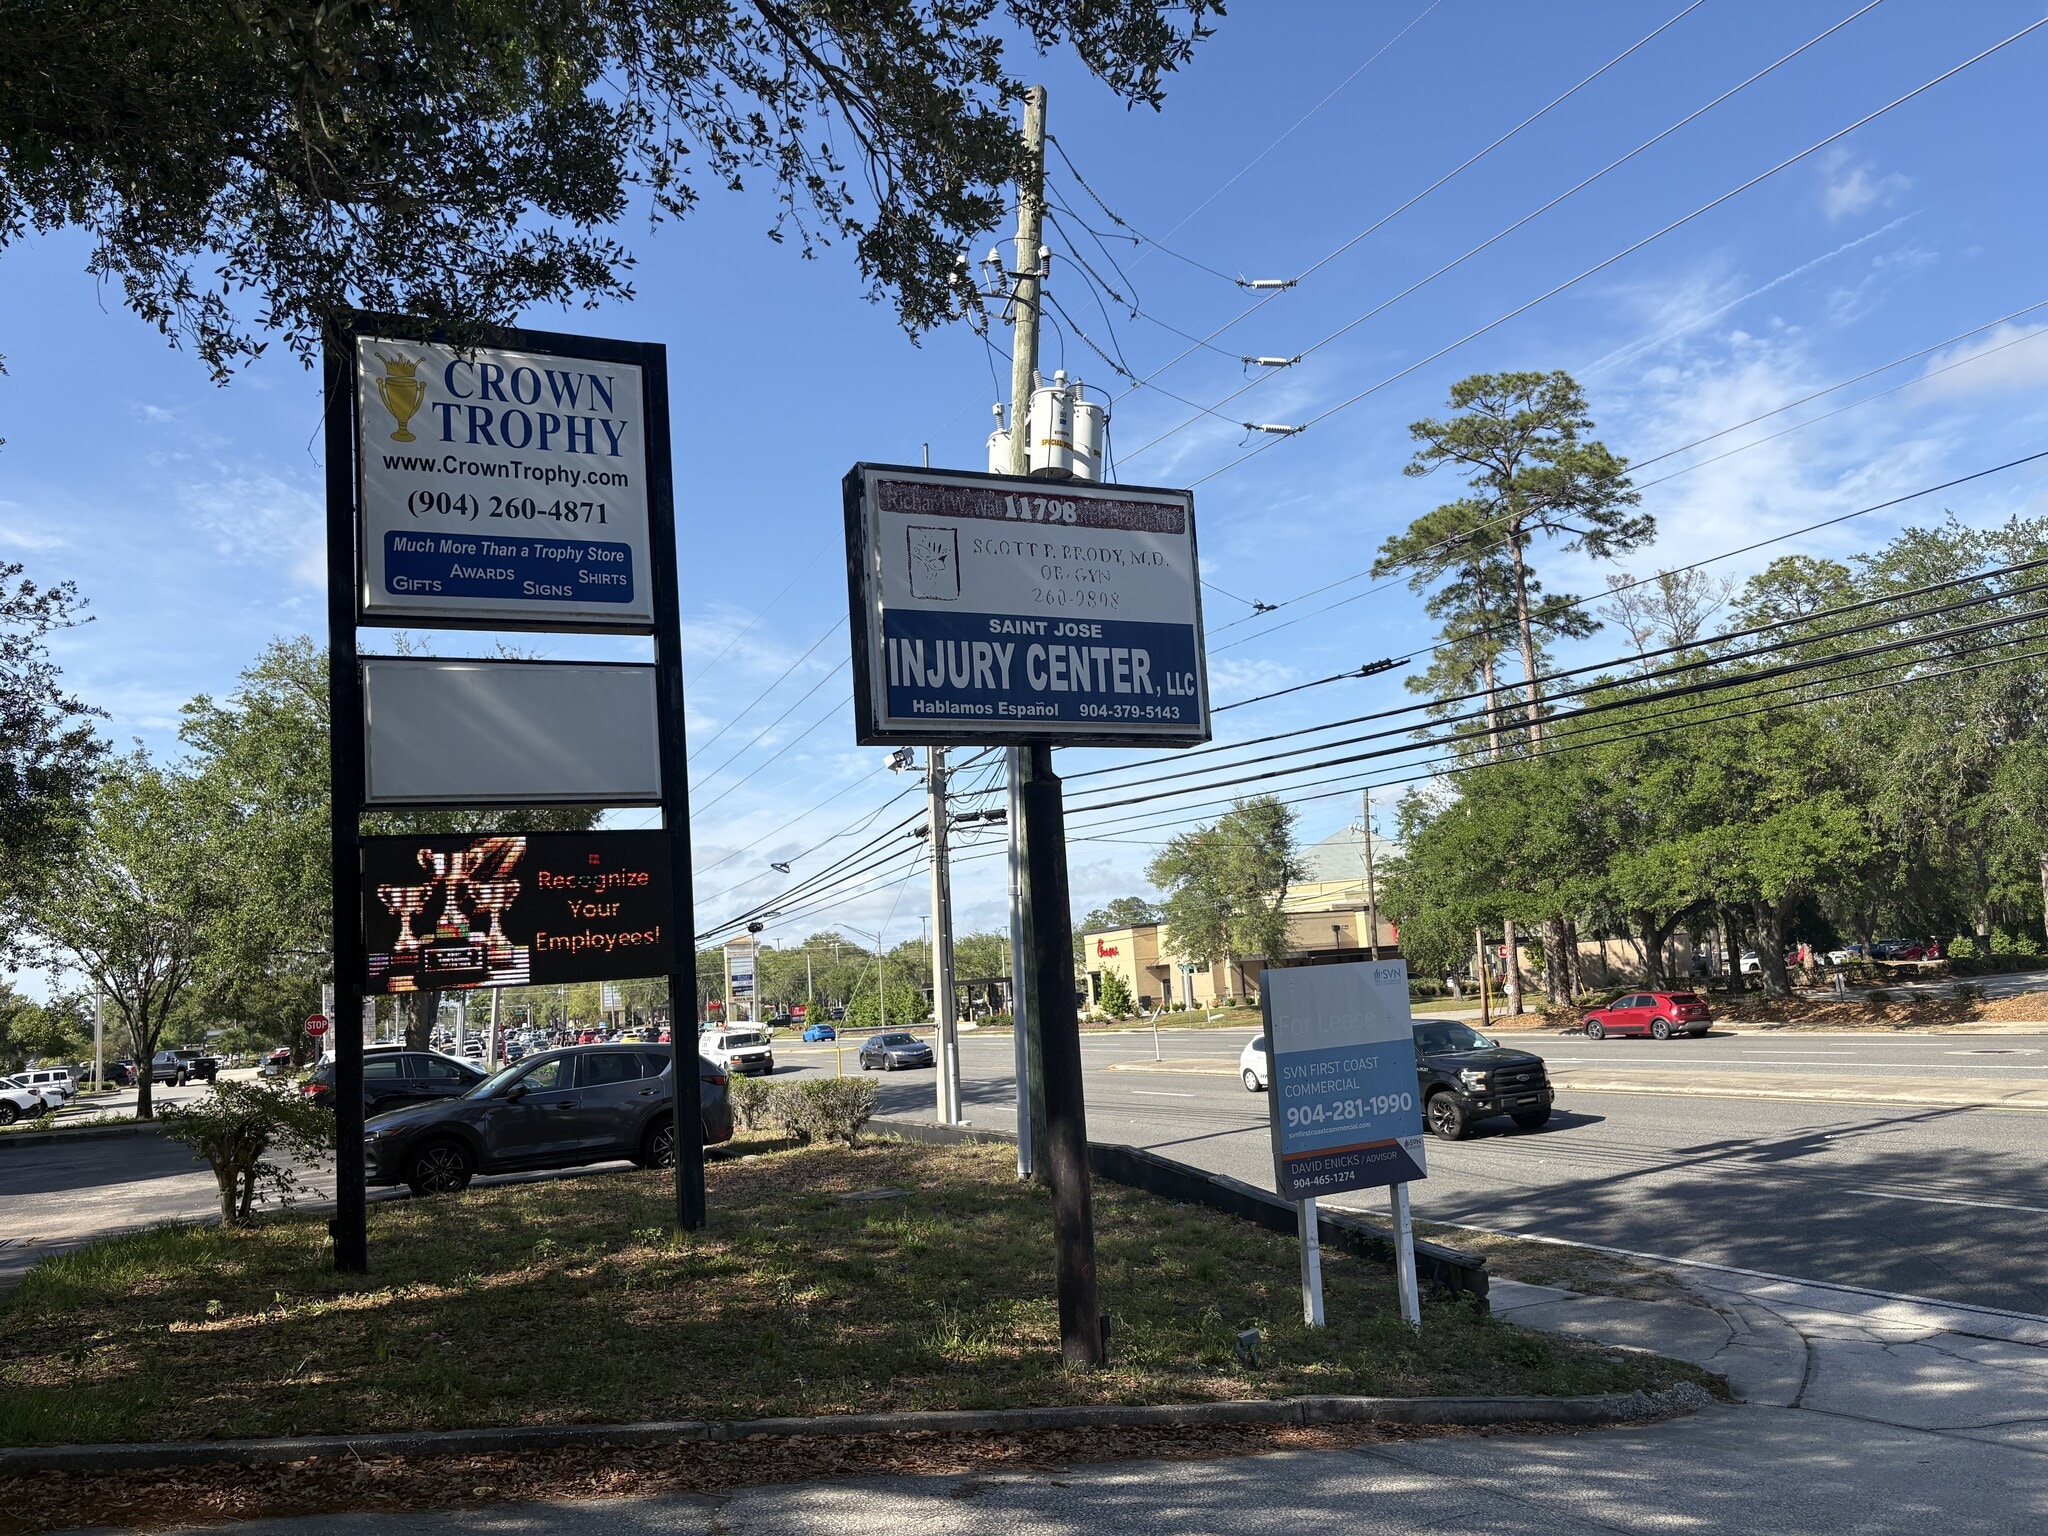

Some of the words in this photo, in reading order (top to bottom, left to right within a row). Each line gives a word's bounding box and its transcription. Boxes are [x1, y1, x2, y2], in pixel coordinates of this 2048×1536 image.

[444, 358, 615, 414] CROWN
[432, 401, 628, 458] TROPHY
[383, 454, 629, 487] www.CrownTrophy.com
[407, 490, 479, 521] (904)
[488, 495, 609, 525] 260-4871
[1004, 495, 1077, 523] 11798
[393, 537, 435, 553] Much
[439, 539, 477, 555] More
[481, 541, 517, 557] Than
[520, 546, 529, 557] a
[534, 544, 583, 563] Trophy
[587, 547, 625, 562] Store
[1131, 550, 1171, 567] M.D.
[449, 563, 515, 580] AWARDS
[578, 569, 627, 586] SHIRTS
[392, 575, 442, 592] GIFTS
[523, 581, 573, 596] SIGNS
[989, 618, 1048, 635] SAINT
[1054, 622, 1103, 638] JOSE
[888, 638, 1015, 690] INJURY
[1026, 643, 1161, 698] CENTER,
[1166, 671, 1195, 696] LLC
[912, 699, 994, 715] Hablamos
[998, 701, 1059, 718] Español
[1079, 703, 1181, 719] 904-379-5143
[538, 868, 649, 893] Recognize
[568, 900, 621, 918] Your
[536, 925, 660, 954] Employees!
[1382, 967, 1401, 979] SVN
[306, 1020, 328, 1030] STOP
[1278, 1013, 1312, 1037] For
[1318, 1010, 1376, 1034] Lease
[1283, 1065, 1307, 1080] SVN
[1310, 1060, 1341, 1076] FIRST
[1343, 1056, 1379, 1072] COAST
[1285, 1077, 1360, 1098] COMMERCIAL
[1287, 1092, 1412, 1127] 904-281-1990
[1288, 1121, 1371, 1139] svnfirstcoastcommercial.com
[1291, 1160, 1323, 1175] DAVID
[1325, 1154, 1360, 1170] ENICKS
[1366, 1151, 1398, 1163] ADVISOR
[1293, 1170, 1356, 1189] 904-465-1274
